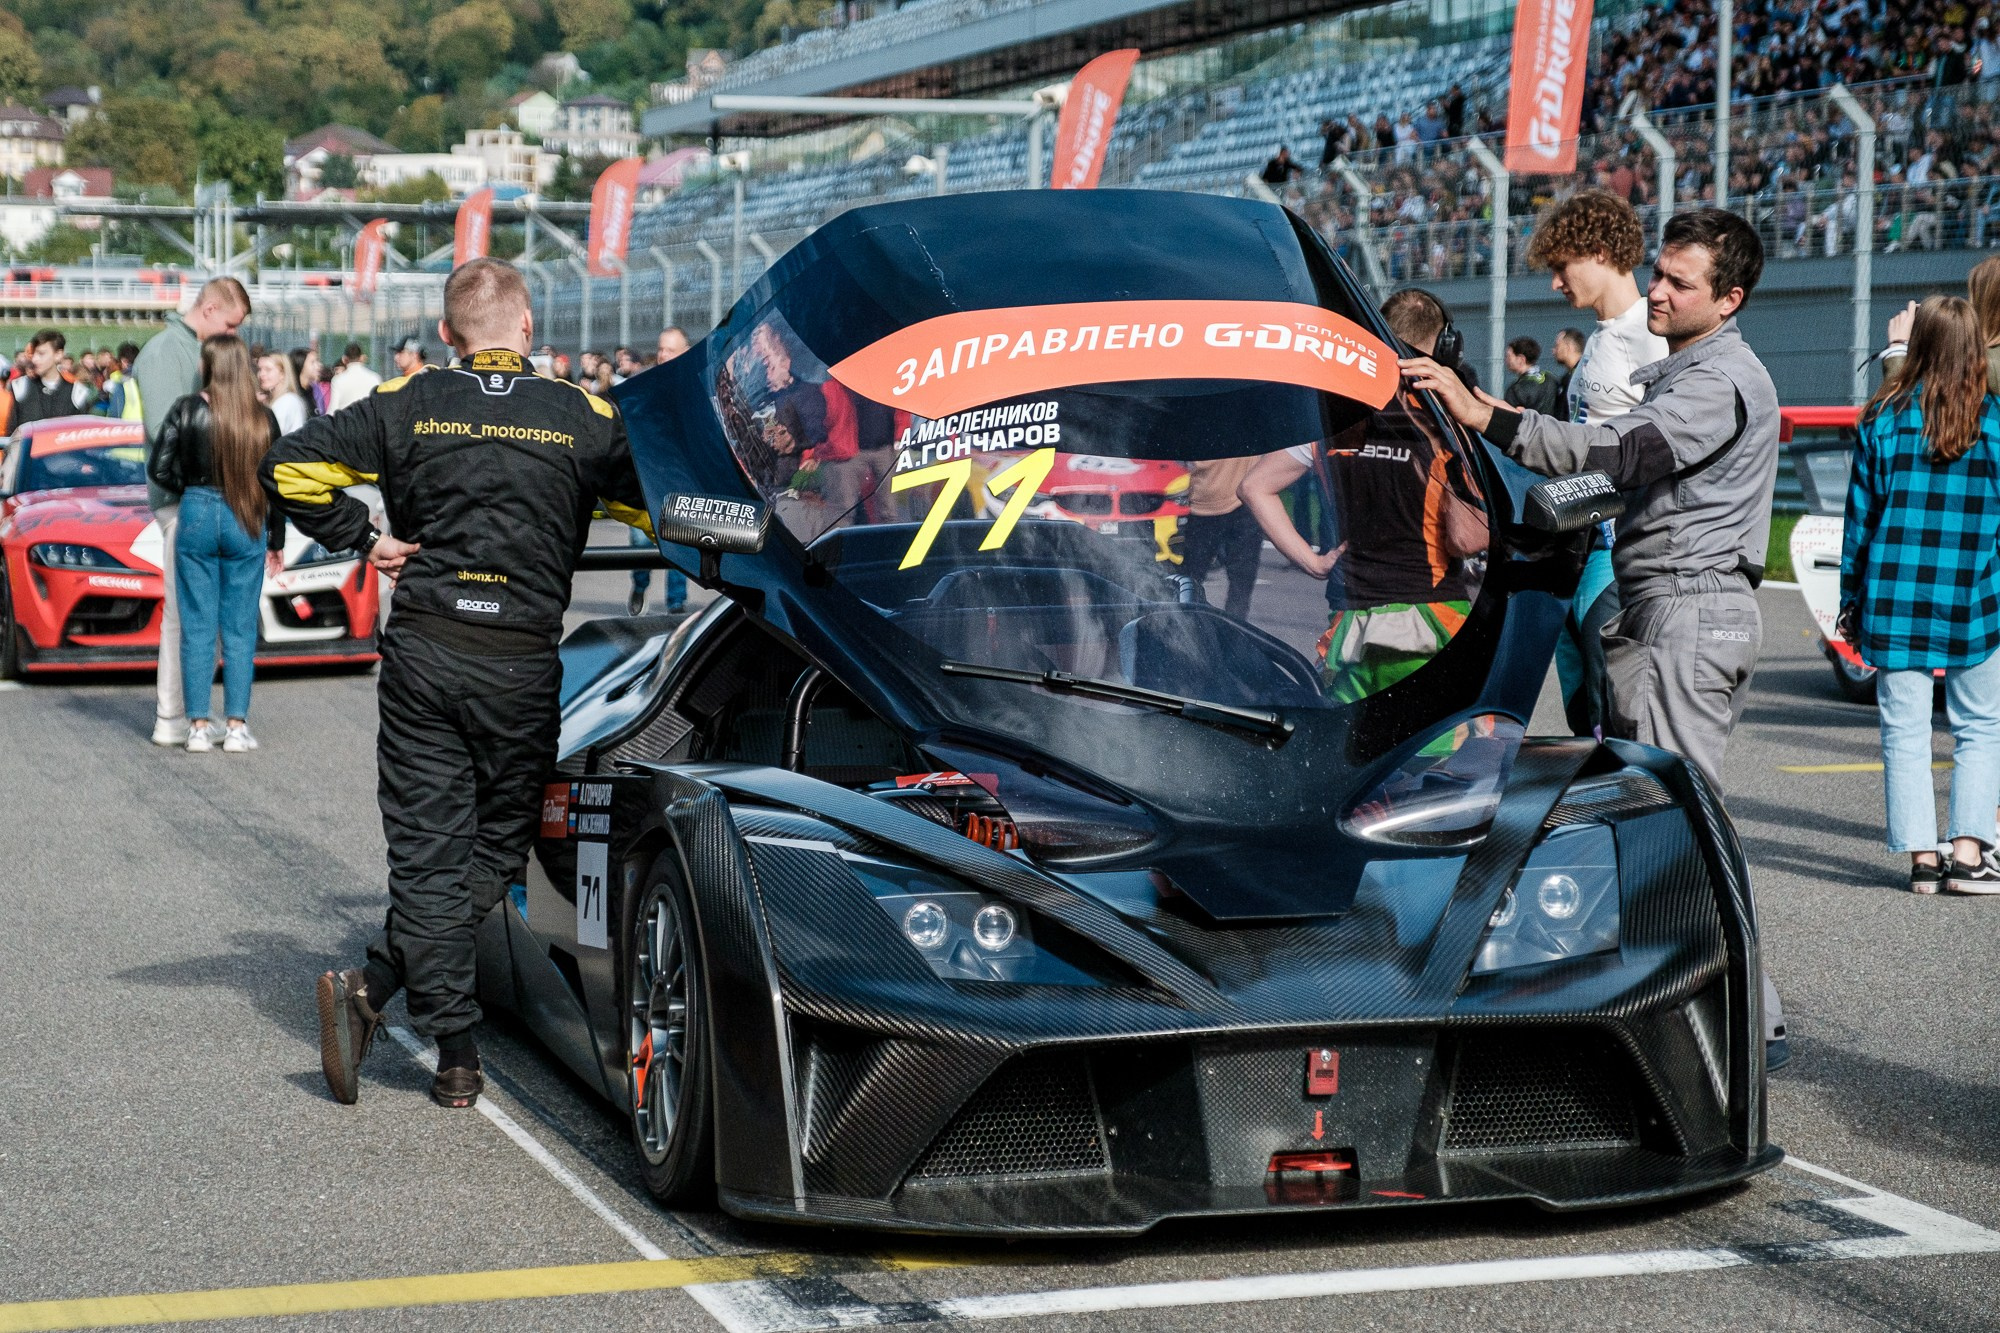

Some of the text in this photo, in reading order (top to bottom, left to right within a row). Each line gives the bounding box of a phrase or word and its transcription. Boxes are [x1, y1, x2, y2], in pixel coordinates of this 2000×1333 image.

[1204, 323, 1377, 378] G-DRIVE
[1294, 322, 1377, 359] ТОПЛИВО
[892, 323, 1184, 396] ЗАПРАВЛЕНО
[414, 417, 574, 448] #shonx_motorsport
[898, 401, 1059, 450] А.МАСЛЕННИКОВ
[895, 423, 1061, 472] А.ГОНЧАРОВ
[1544, 473, 1612, 497] REITER
[1553, 485, 1616, 505] ENGINEERING
[673, 509, 754, 527] ENGINEERING
[674, 496, 756, 519] REITER
[890, 447, 1056, 571] 71
[457, 570, 508, 583] shonx.ru
[582, 875, 600, 921] 71
